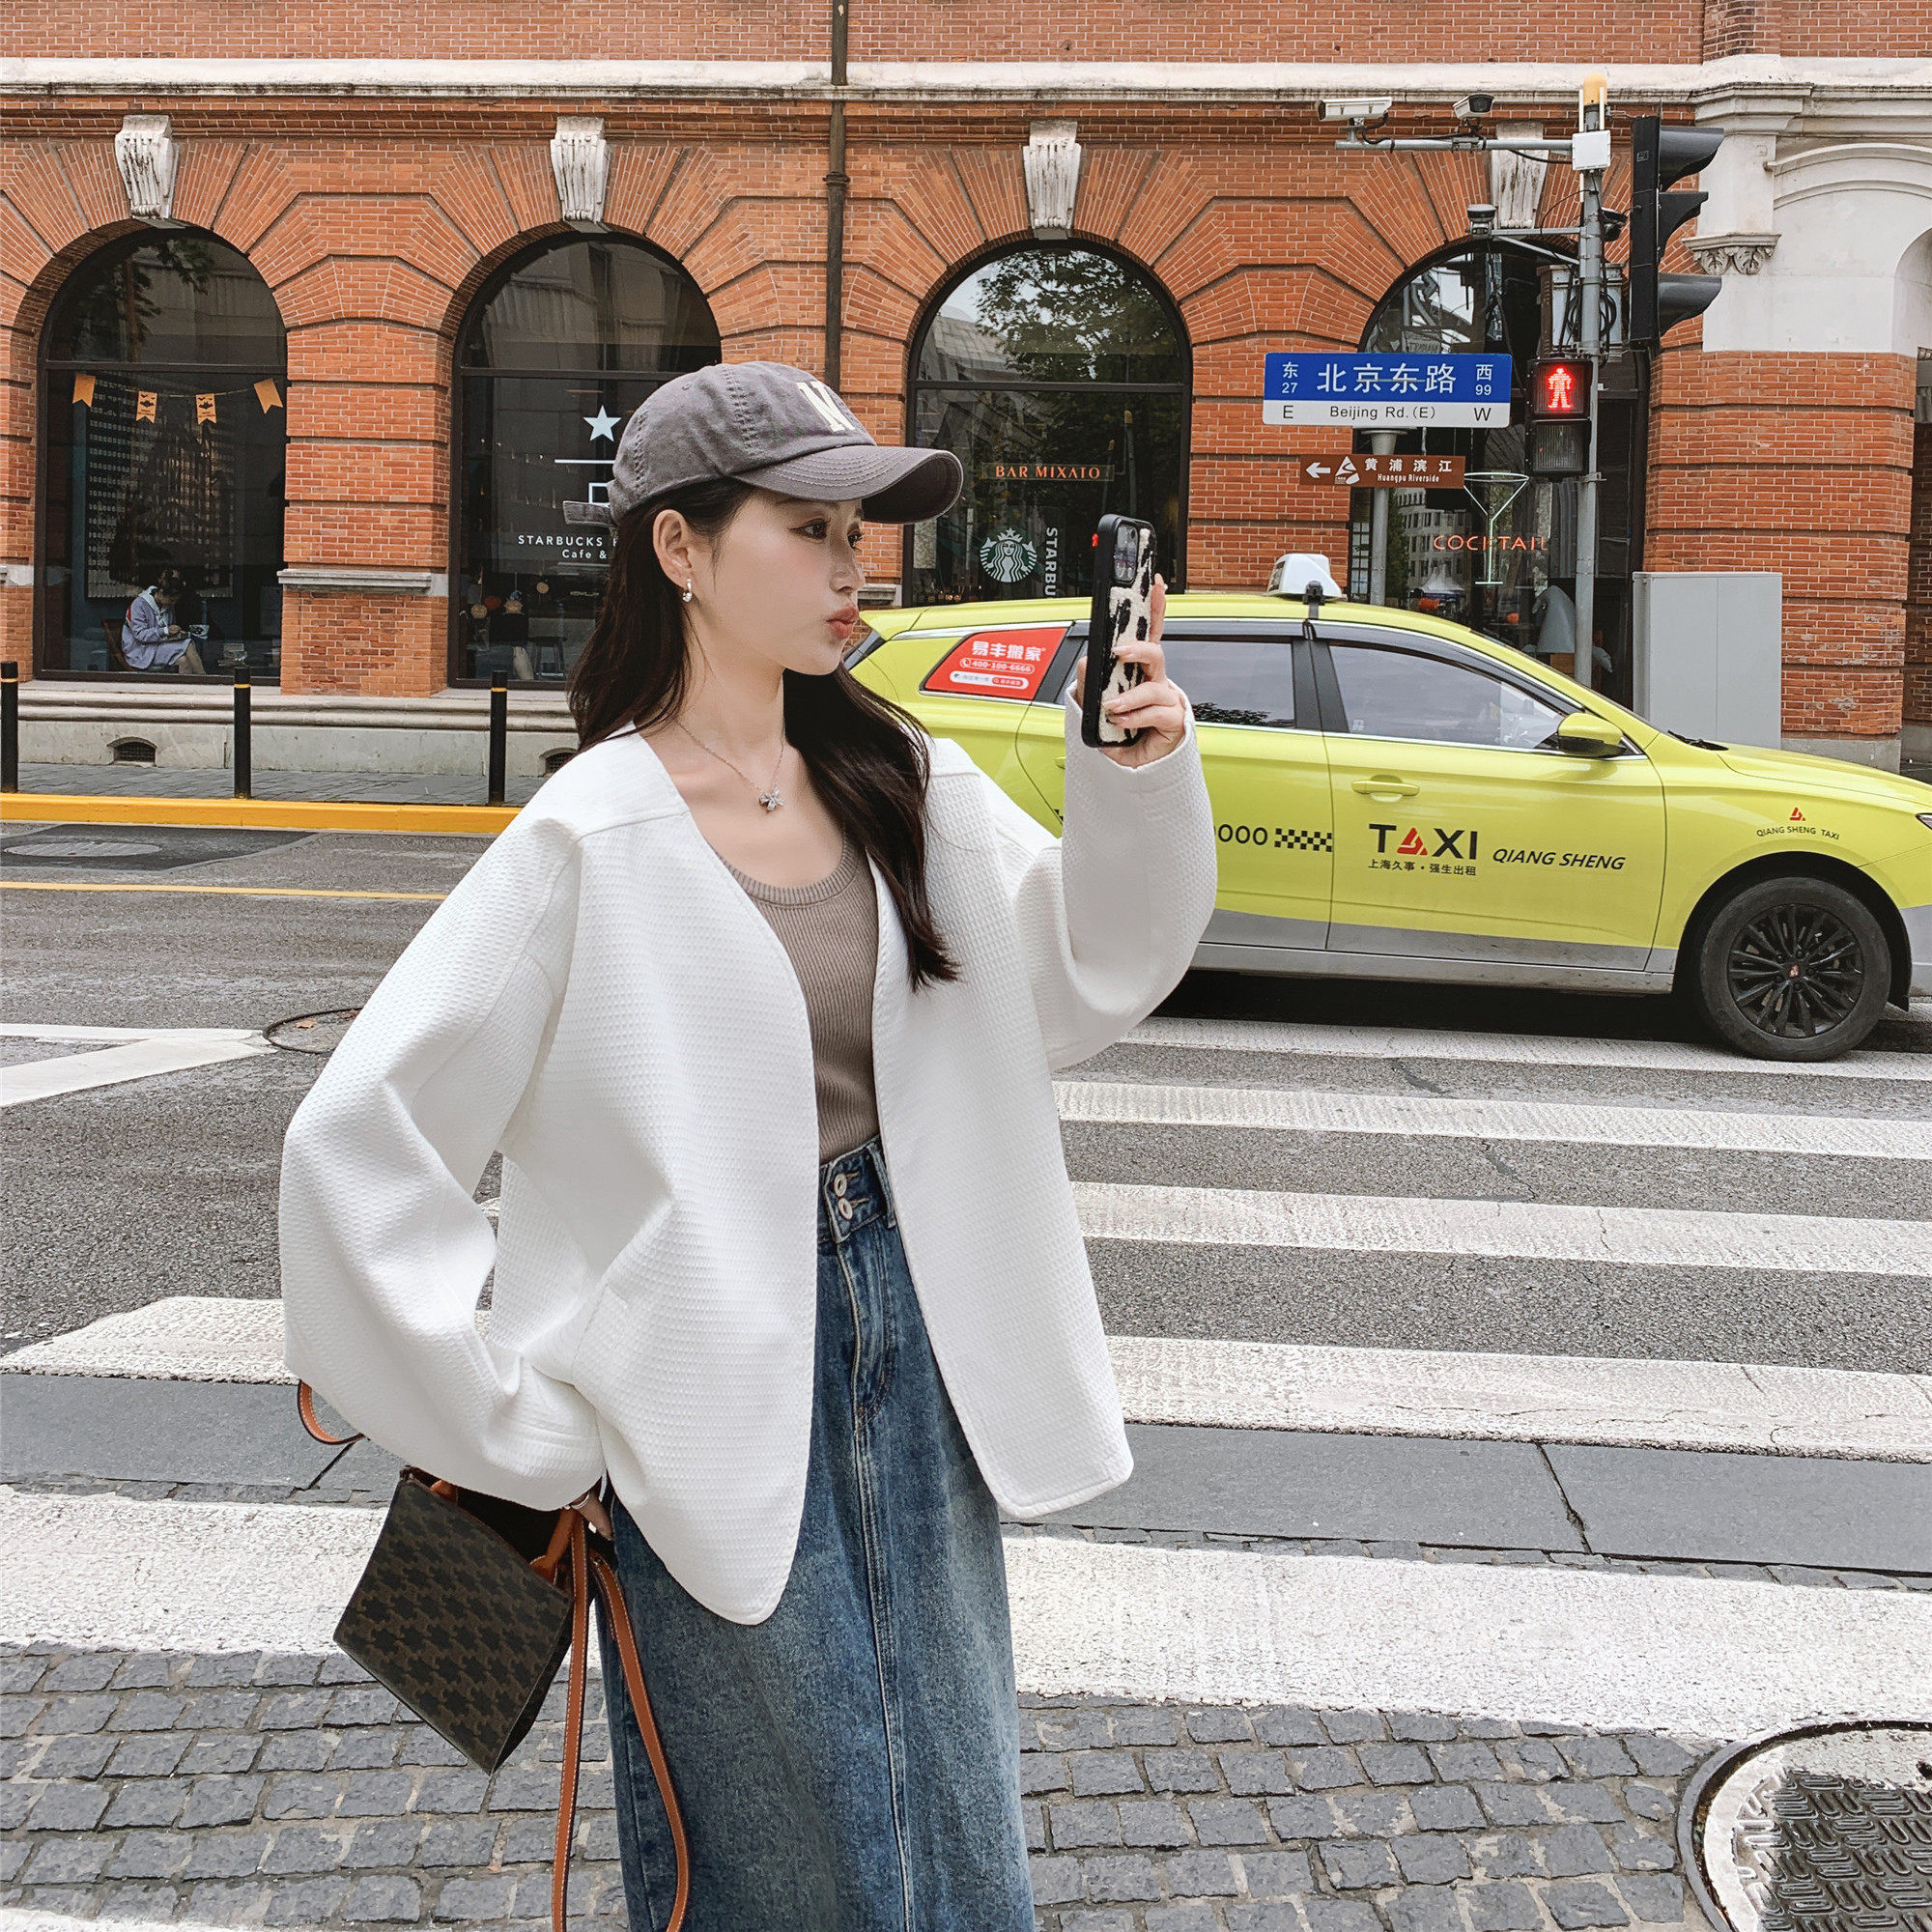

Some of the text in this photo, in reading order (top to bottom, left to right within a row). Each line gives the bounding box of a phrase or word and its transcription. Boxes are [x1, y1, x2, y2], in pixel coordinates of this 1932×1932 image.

[1282, 361, 1299, 379] 东
[1475, 363, 1493, 382] 西
[1316, 362, 1457, 394] 北京东路
[1281, 383, 1298, 394] 27
[1475, 384, 1492, 396] 99
[1283, 405, 1294, 419] E
[1330, 406, 1378, 421] Beijing
[1473, 407, 1492, 422] W
[995, 465, 1101, 480] BAR MIXATO
[1364, 457, 1453, 473] 黄浦滨江
[1378, 473, 1440, 483] Huangpu Riverside
[518, 534, 604, 548] STARBUCKS
[561, 549, 608, 559] Cafe &
[1044, 526, 1059, 597] STARBU
[1214, 823, 1268, 846] 000
[1756, 826, 1840, 840] QIANG SHENG TAXI
[1492, 848, 1626, 870] QIANG SHENG
